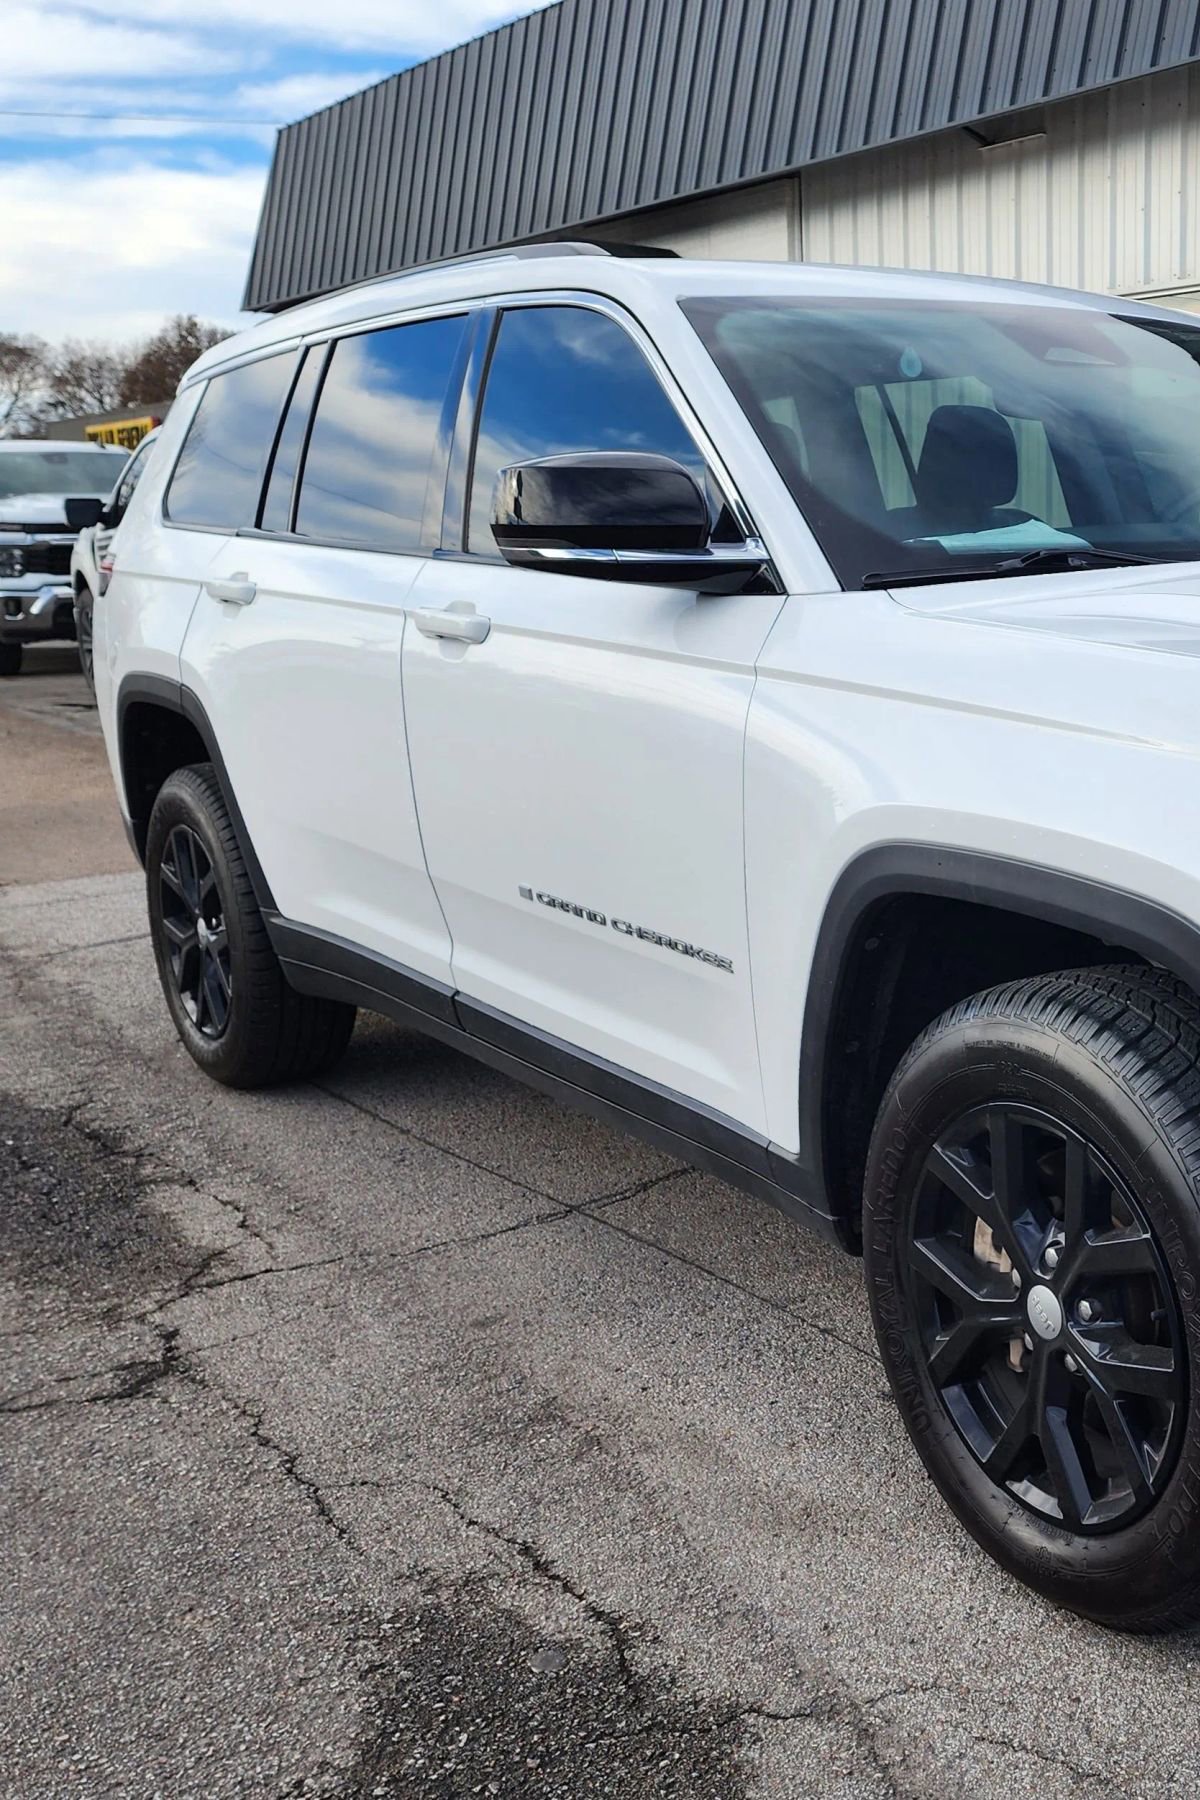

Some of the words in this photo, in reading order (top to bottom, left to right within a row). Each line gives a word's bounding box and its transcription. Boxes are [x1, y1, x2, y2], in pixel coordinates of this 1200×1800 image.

[536, 891, 607, 927] GRAND
[610, 917, 735, 974] CHEROKEE
[874, 1268, 932, 1436] UNIROYAL
